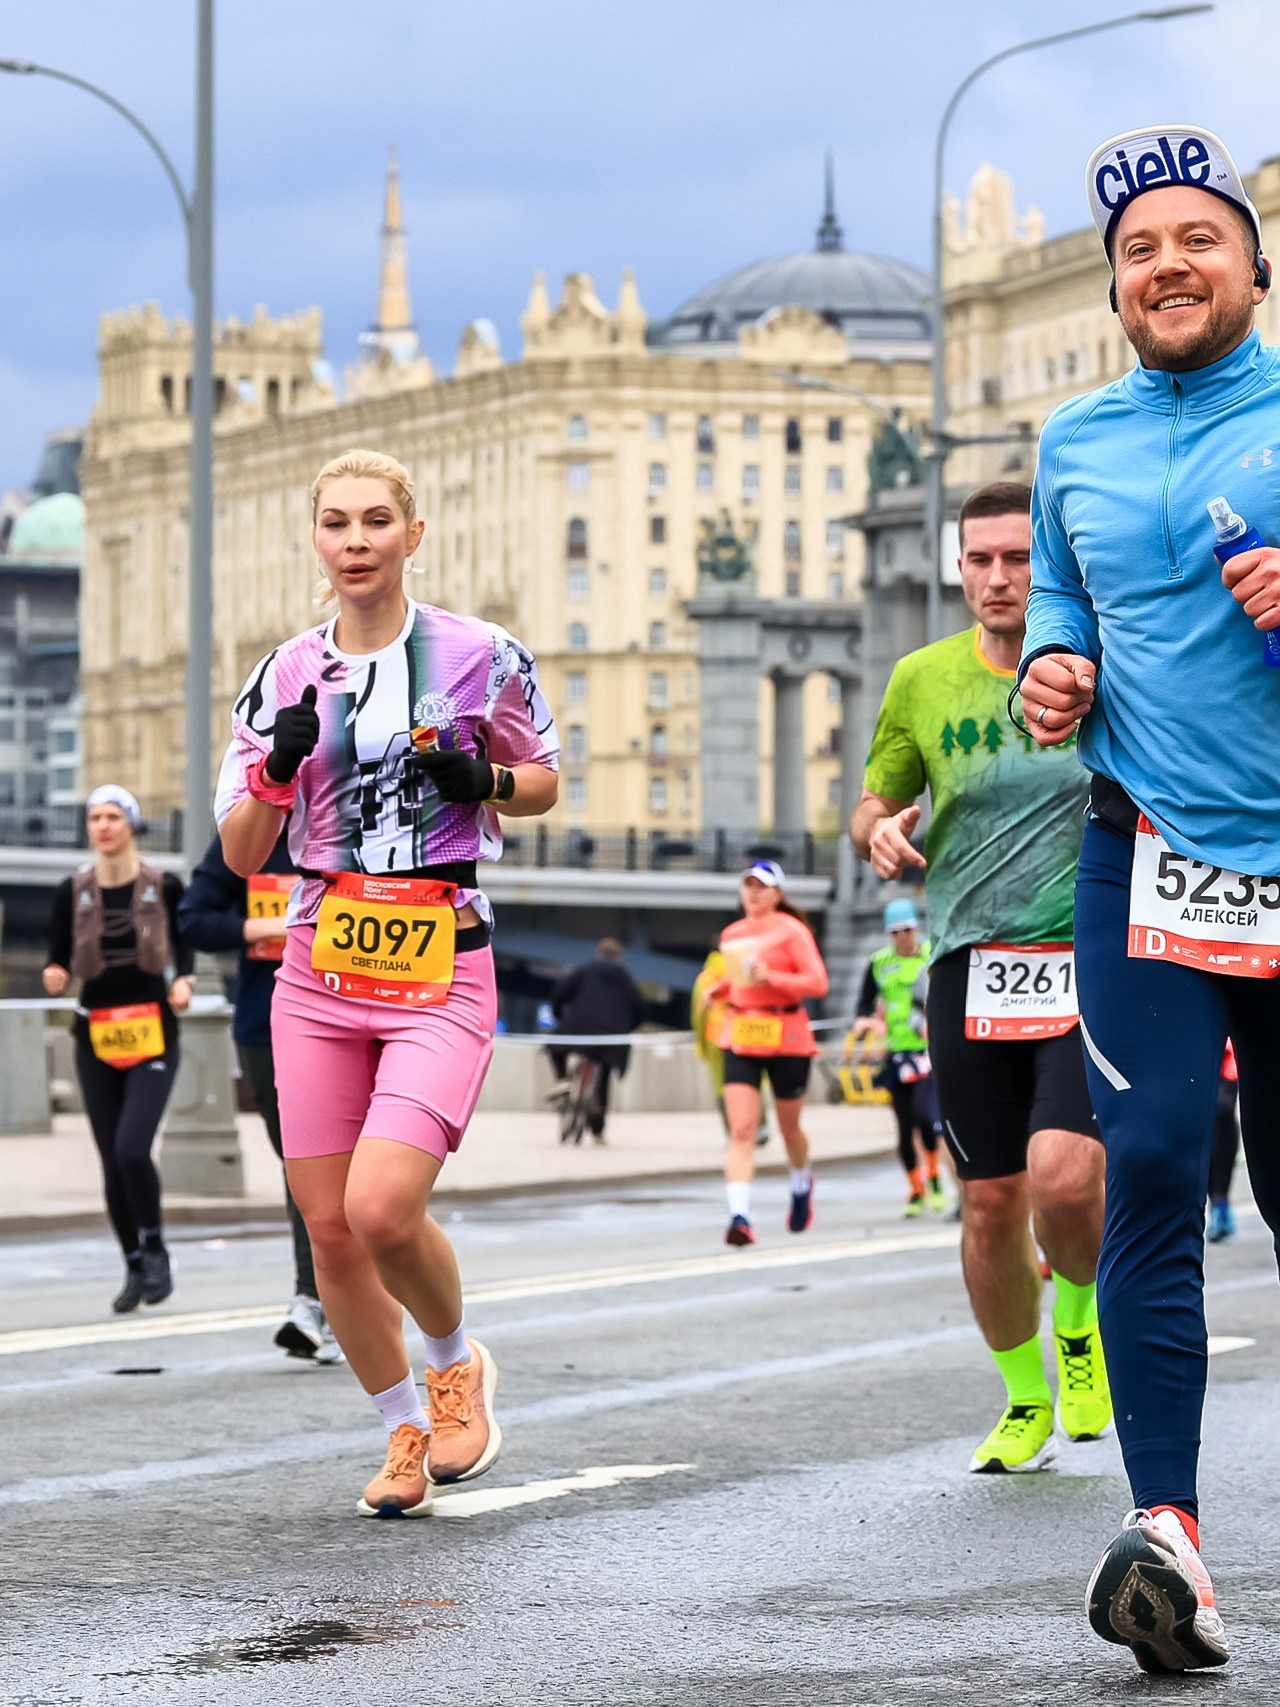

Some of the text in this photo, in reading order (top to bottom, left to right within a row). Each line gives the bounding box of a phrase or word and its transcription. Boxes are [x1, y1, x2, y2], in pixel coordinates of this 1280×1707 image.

[1096, 136, 1210, 210] ciele
[253, 901, 289, 917] 11
[1180, 907, 1259, 927] АЛЕКСЕЙ
[332, 912, 437, 958] 3097
[1145, 929, 1167, 956] D
[351, 955, 412, 972] СВЕТЛАНА
[324, 972, 341, 992] D
[986, 961, 1071, 994] 3261
[1000, 995, 1057, 1007] ДМИТРИЙ
[976, 1018, 992, 1037] D
